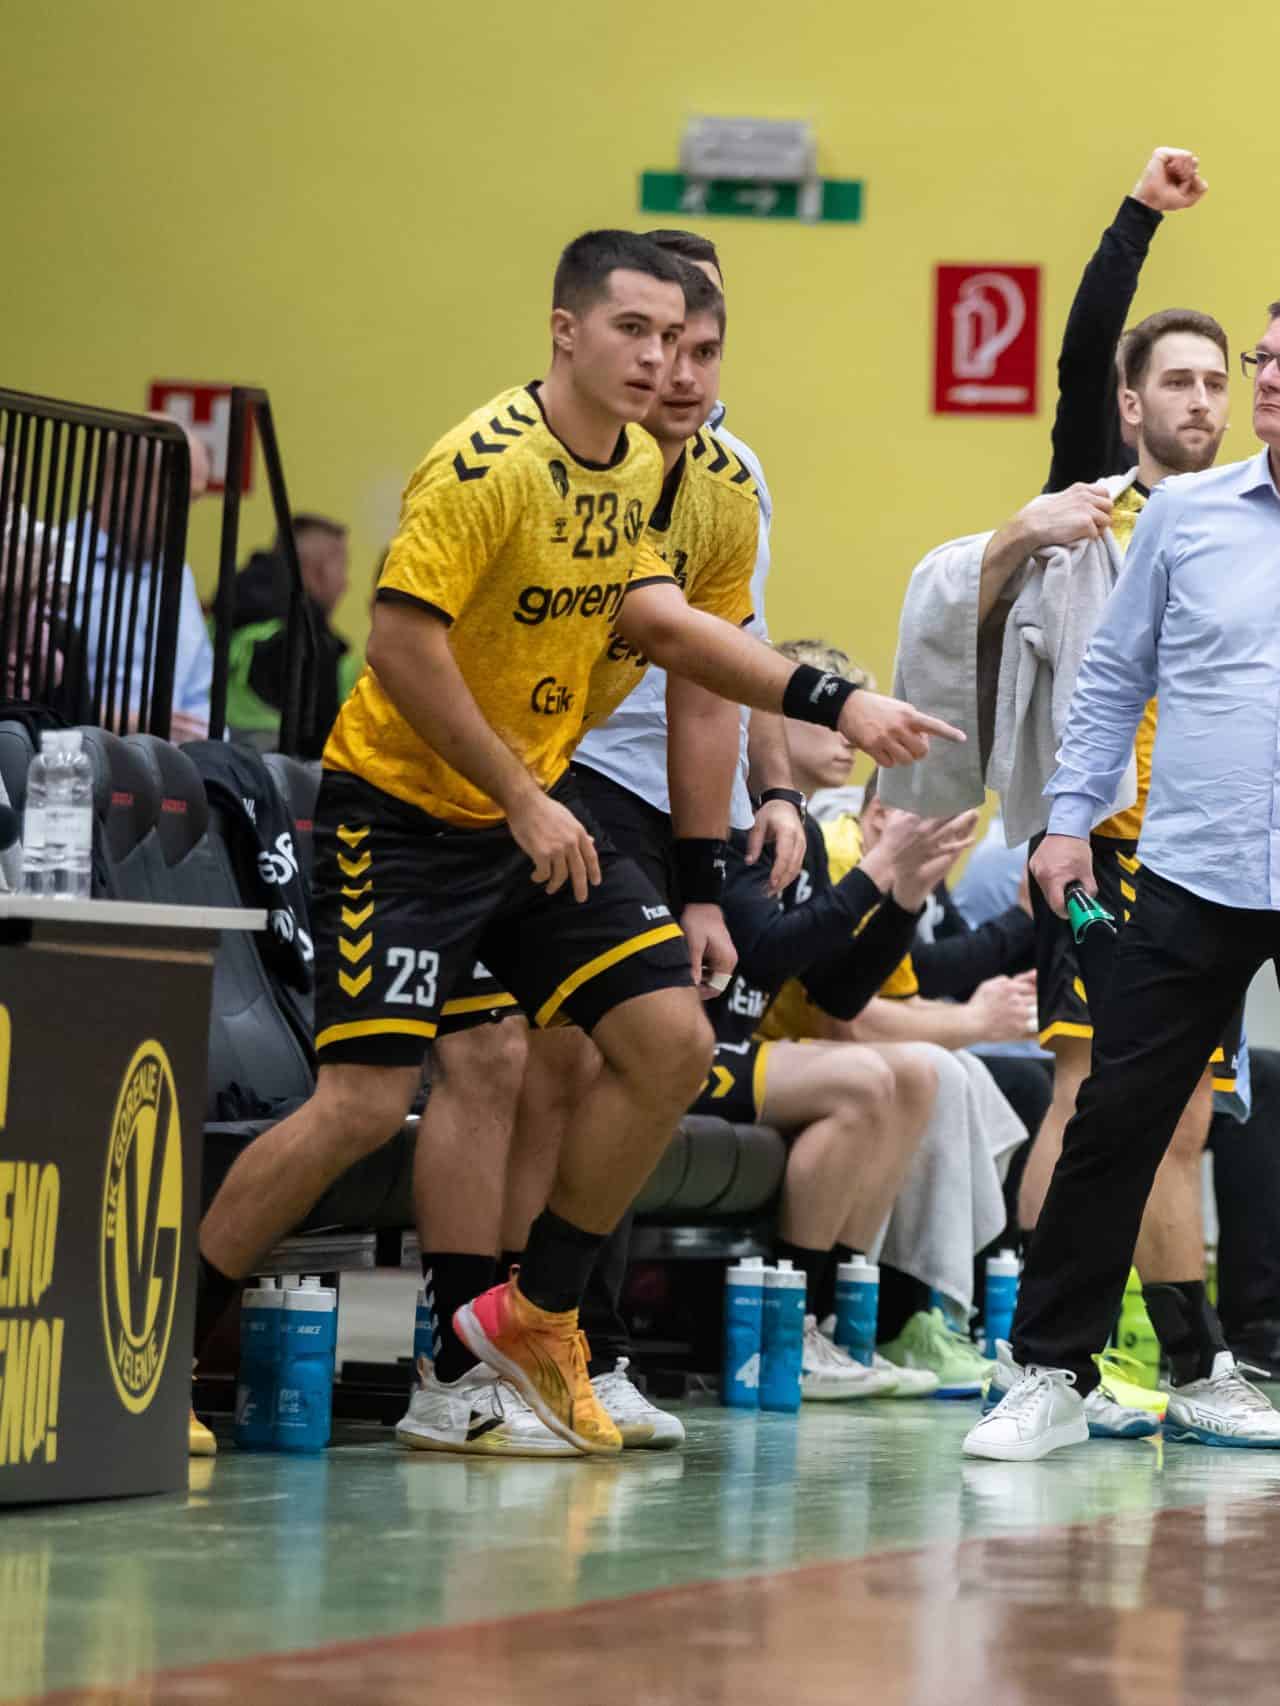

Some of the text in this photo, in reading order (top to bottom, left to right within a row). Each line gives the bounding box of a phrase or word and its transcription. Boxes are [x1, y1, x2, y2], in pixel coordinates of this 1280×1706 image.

[572, 492, 619, 559] 23
[513, 582, 626, 626] gorenj
[384, 946, 440, 1008] 23
